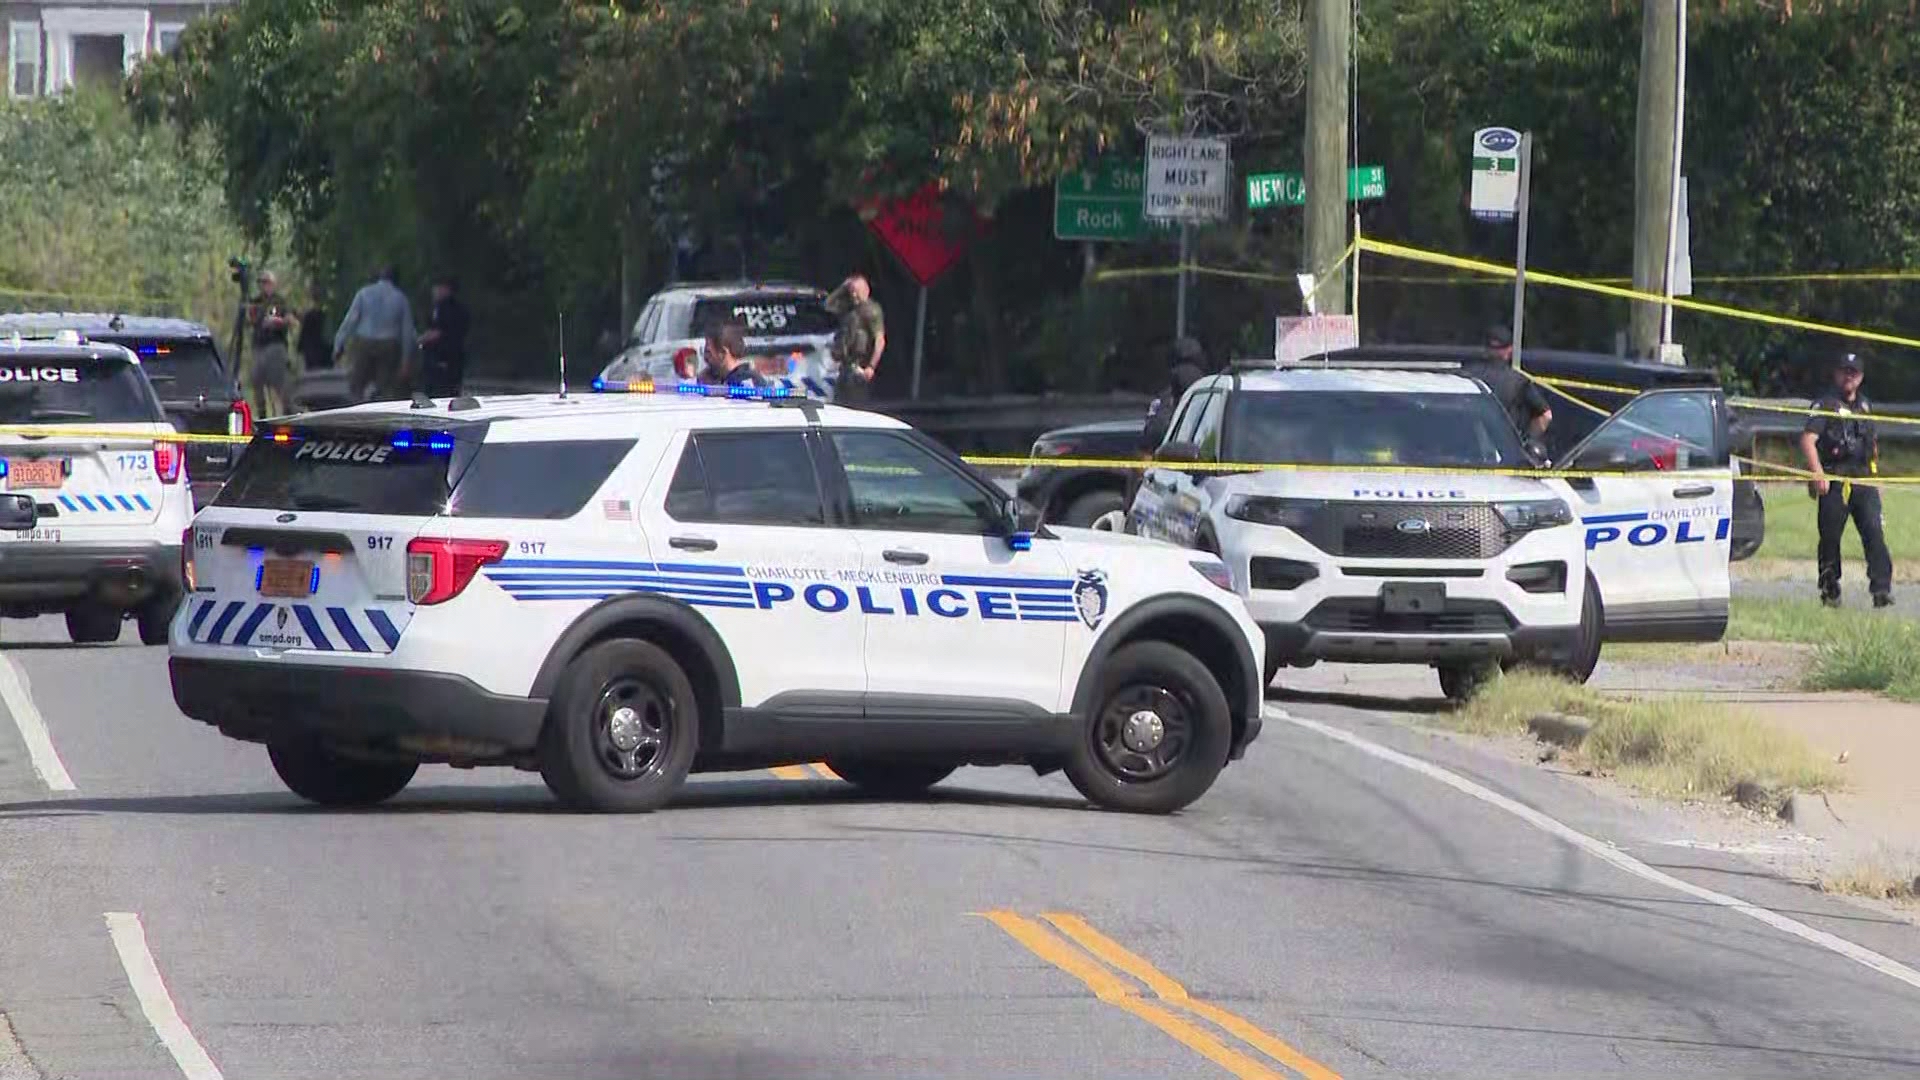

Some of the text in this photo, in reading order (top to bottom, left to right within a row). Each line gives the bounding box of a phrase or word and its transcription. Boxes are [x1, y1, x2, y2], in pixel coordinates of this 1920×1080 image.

[1152, 144, 1223, 161] RIGHT LANE
[1490, 157, 1499, 171] 3
[1165, 169, 1208, 185] MUST
[1077, 208, 1124, 229] Rock
[734, 304, 797, 317] POLICE
[296, 441, 394, 463] POLICE
[117, 455, 149, 470] 173
[1354, 490, 1466, 498] POLICE
[1651, 507, 1720, 520] CHARLOTTE
[367, 536, 393, 549] 917
[520, 541, 546, 554] 917
[746, 567, 828, 581] CHARLOTTE
[838, 570, 940, 585] MECKLENBURG
[753, 582, 1018, 620] POLICE
[259, 632, 302, 646] cmpd.org
